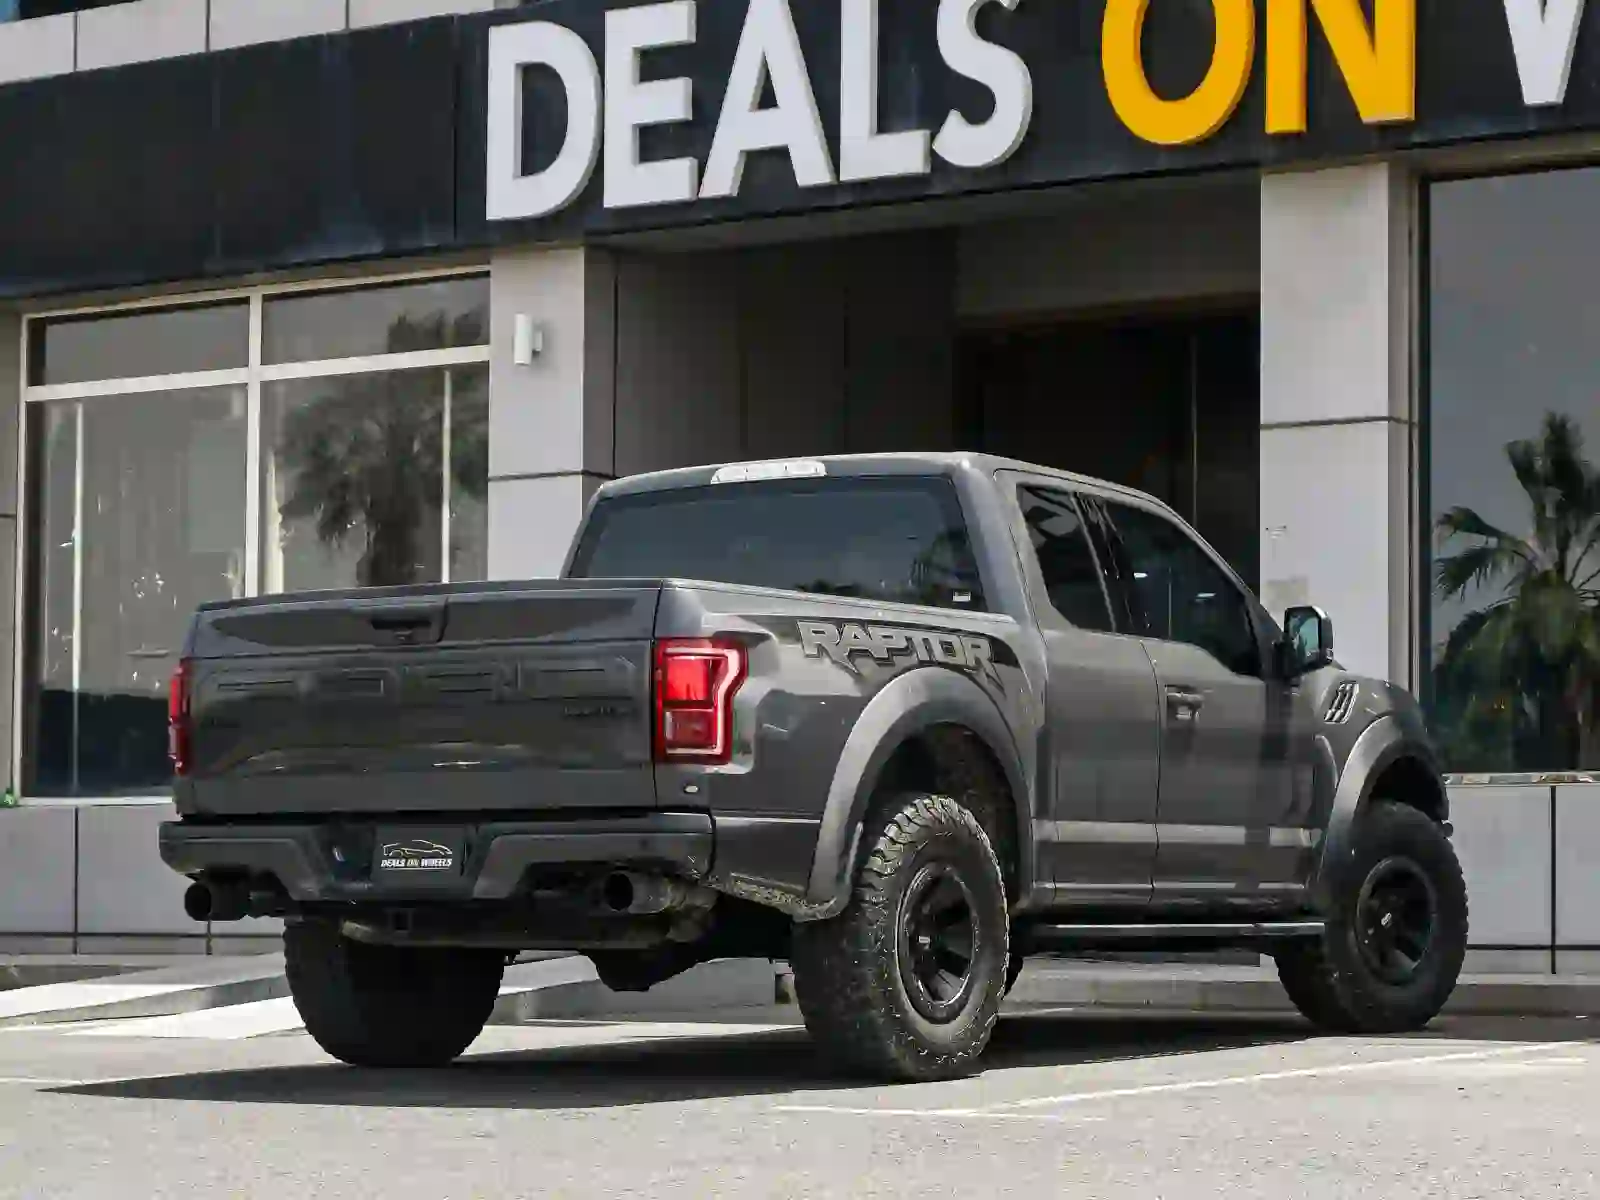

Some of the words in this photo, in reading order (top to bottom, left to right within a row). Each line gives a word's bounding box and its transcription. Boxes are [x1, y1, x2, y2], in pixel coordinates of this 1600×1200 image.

[486, 0, 1033, 220] DEALS
[1101, 0, 1416, 145] ON
[796, 618, 1002, 676] RAPTOR
